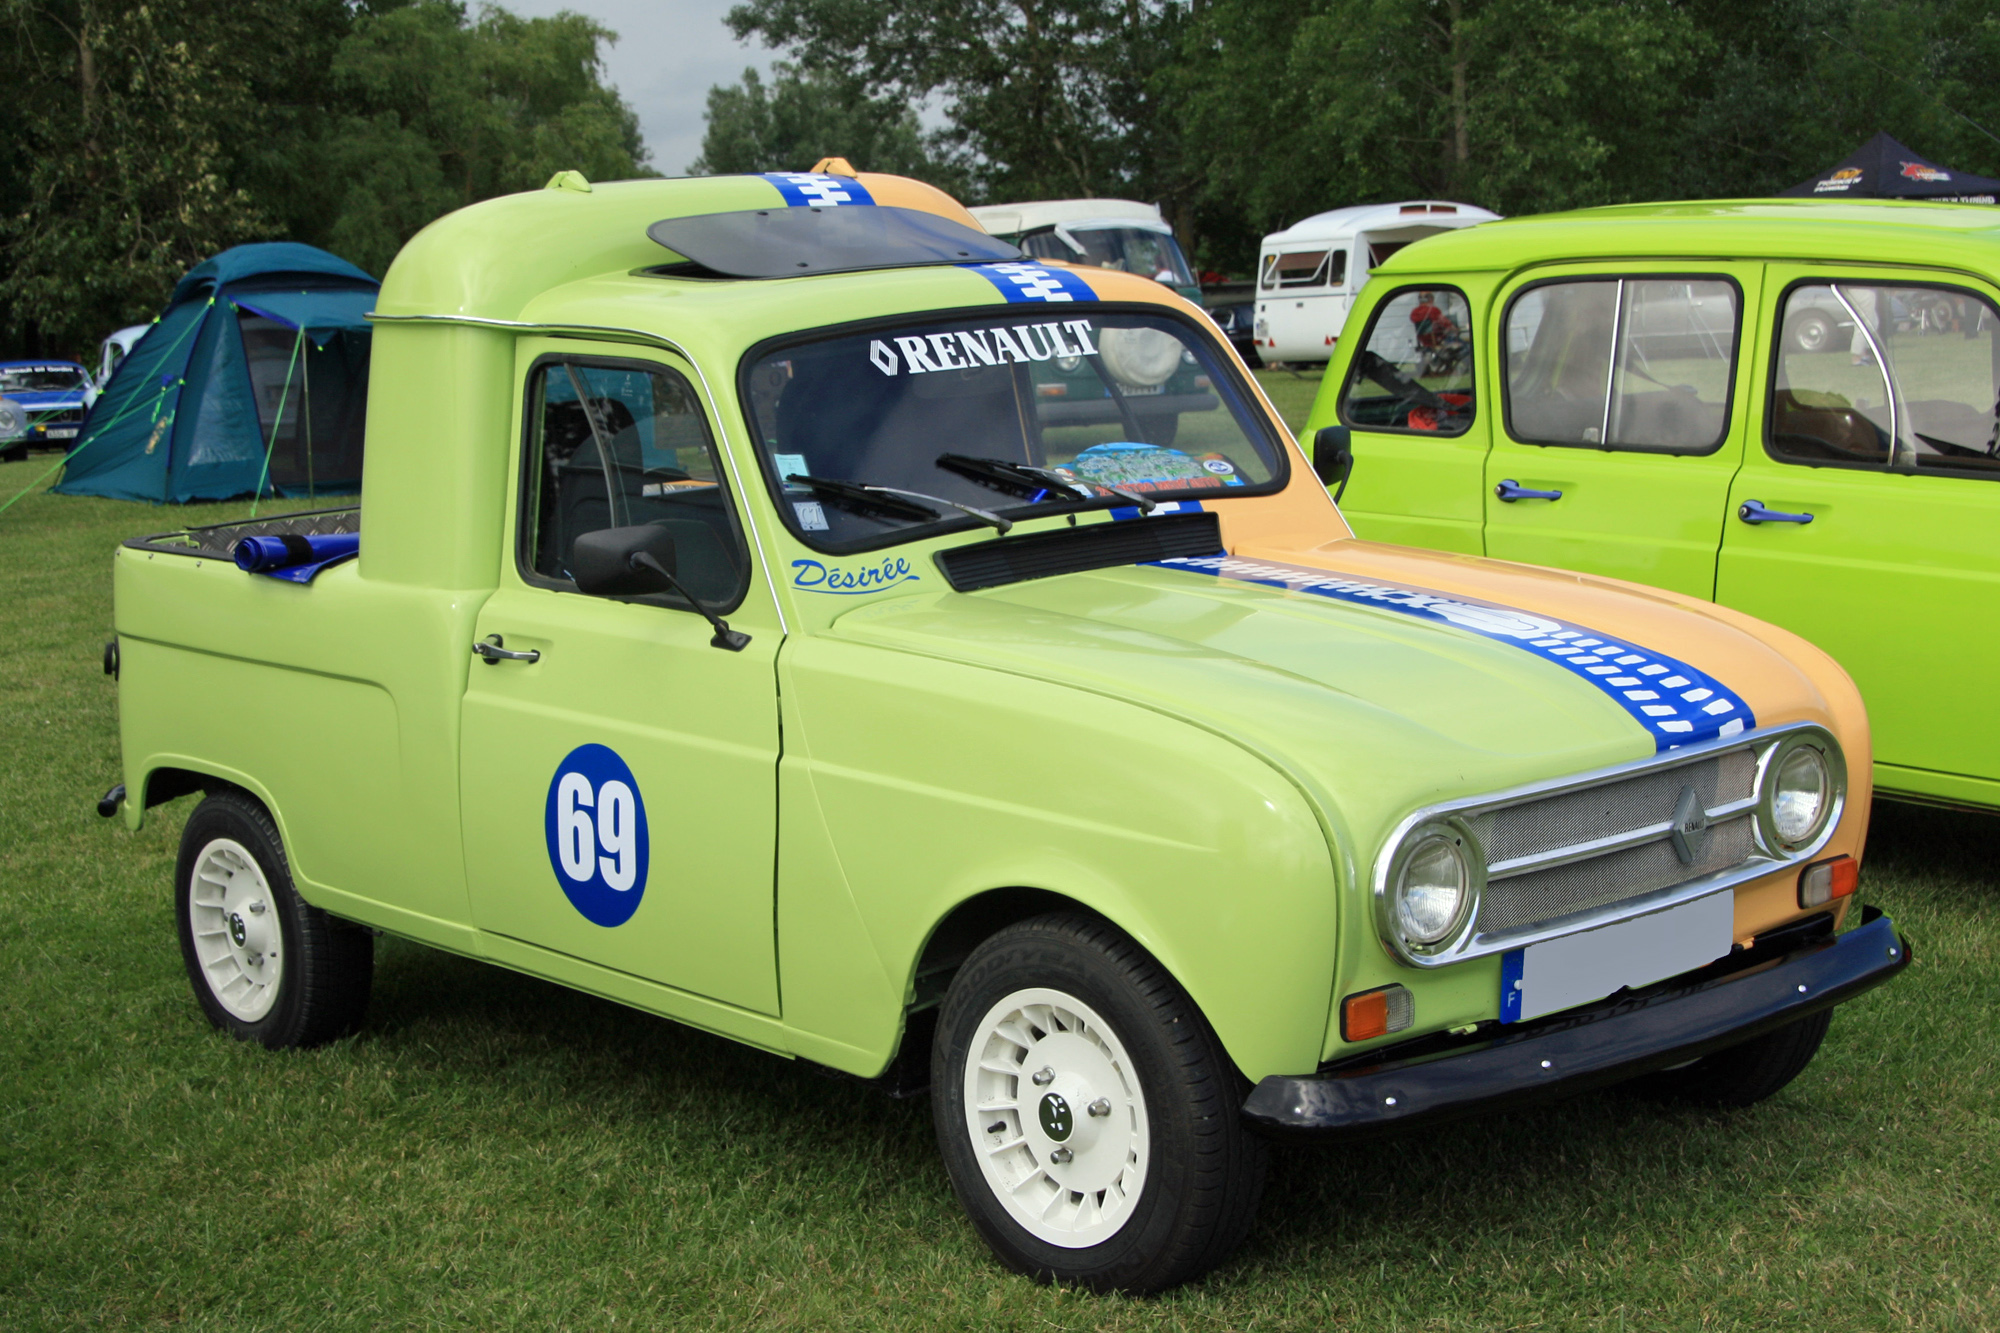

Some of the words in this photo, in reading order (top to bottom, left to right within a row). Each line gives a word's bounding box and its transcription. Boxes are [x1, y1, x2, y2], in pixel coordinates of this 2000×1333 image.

[893, 319, 1099, 374] RENAULT
[791, 557, 912, 590] Désirée
[557, 772, 637, 892] 69
[1507, 991, 1516, 1008] F
